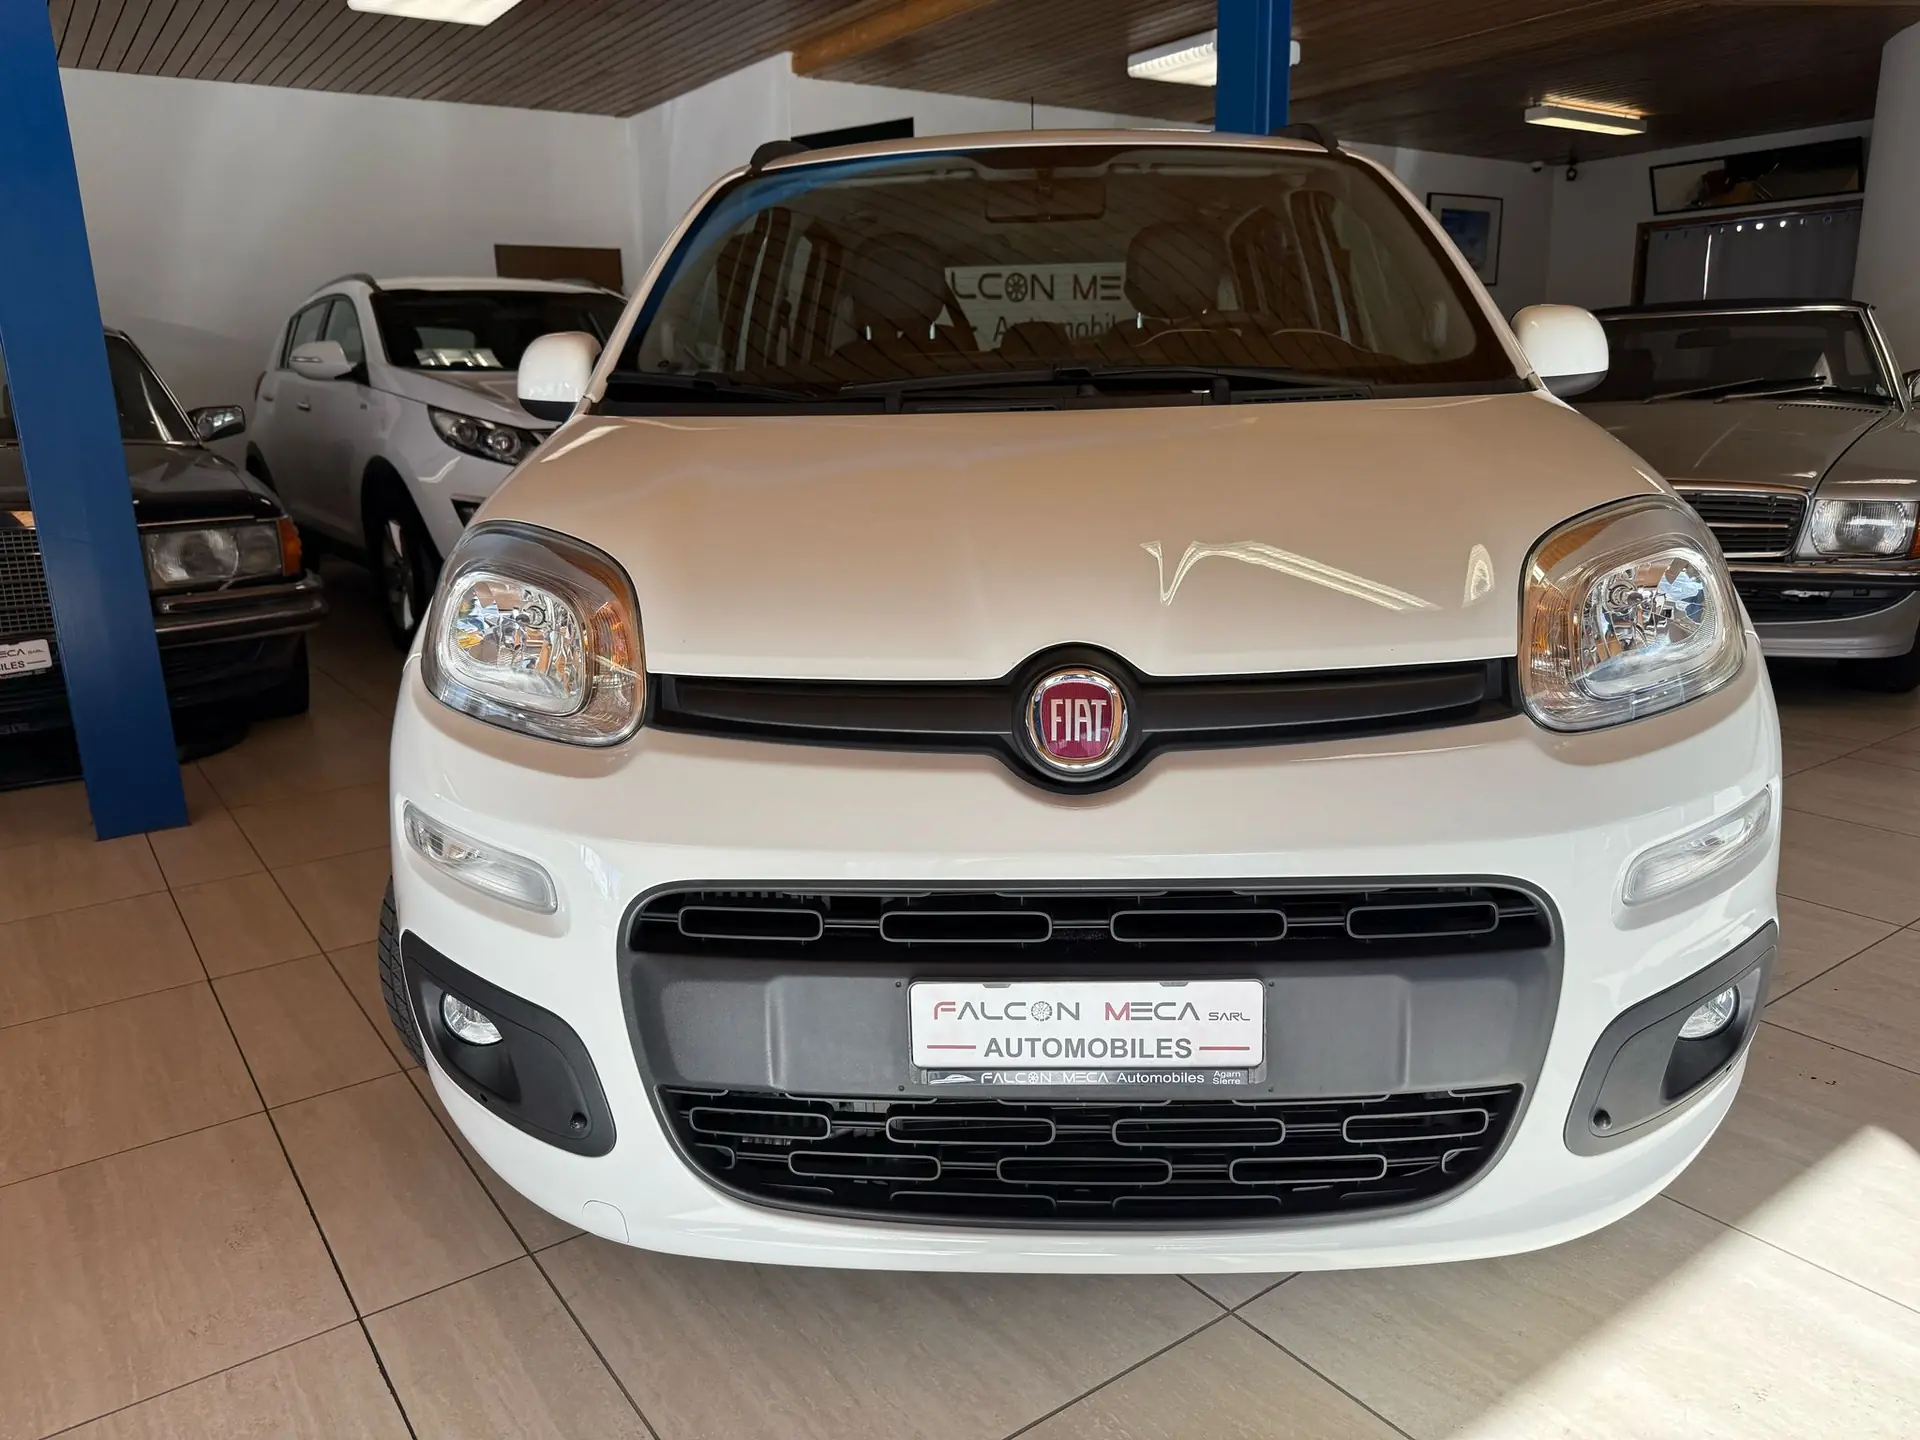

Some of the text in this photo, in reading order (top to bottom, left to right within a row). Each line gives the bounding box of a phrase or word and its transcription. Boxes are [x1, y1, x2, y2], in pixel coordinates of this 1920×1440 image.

[1050, 698, 1107, 742] FIAT
[933, 1000, 1251, 1021] FALCON MECA SARL
[983, 1036, 1193, 1060] AUTOMOBILES
[981, 1072, 1205, 1084] FALCON MECA Automobiles
